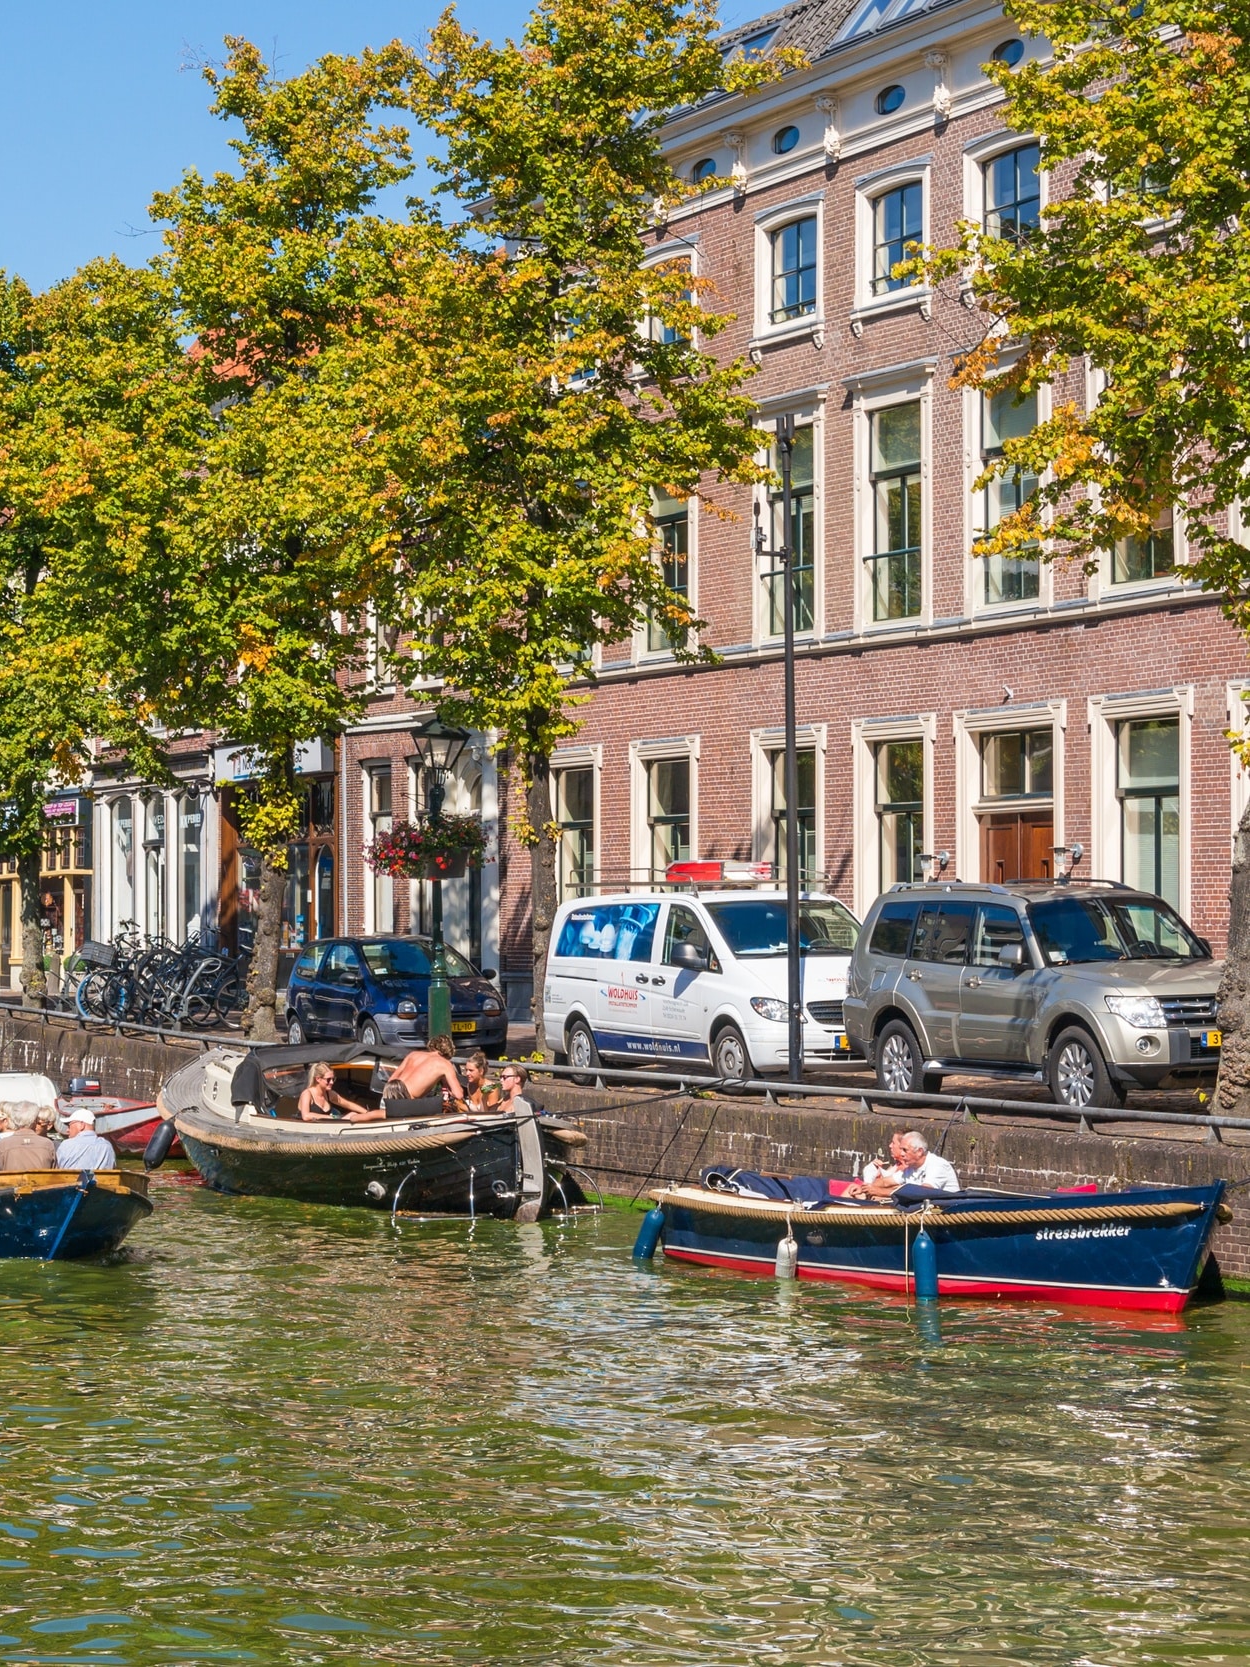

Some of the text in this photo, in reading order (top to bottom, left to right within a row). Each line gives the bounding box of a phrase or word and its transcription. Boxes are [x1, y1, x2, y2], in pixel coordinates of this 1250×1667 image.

[608, 985, 638, 1001] WOLDHUIS
[626, 1041, 681, 1053] www.woldhuis.nl
[1035, 1223, 1132, 1241] stressbrekker
